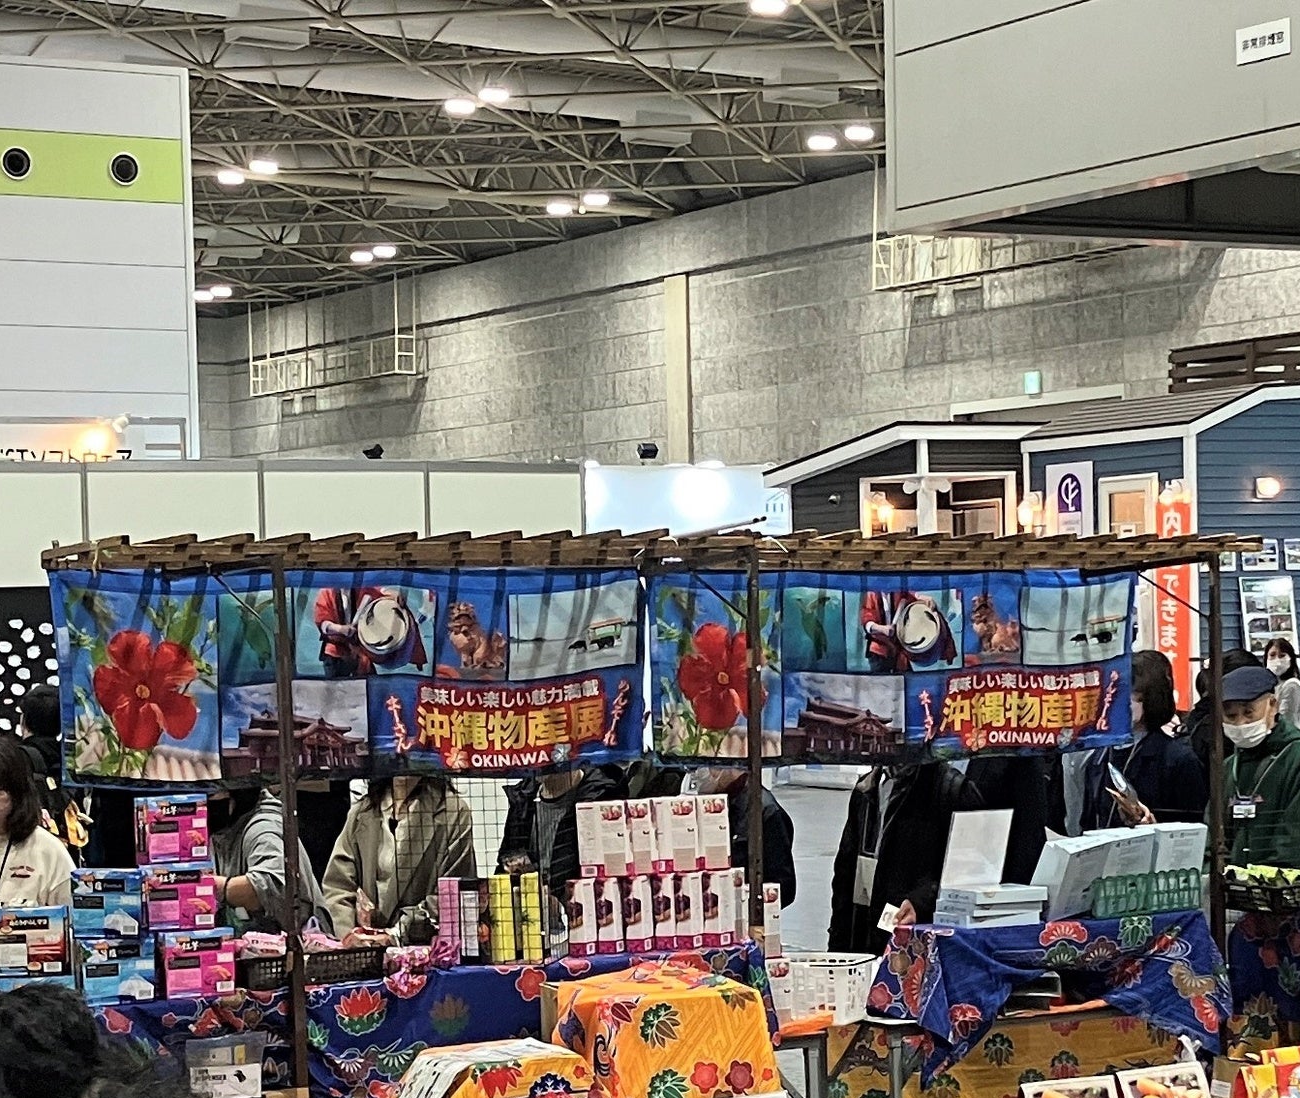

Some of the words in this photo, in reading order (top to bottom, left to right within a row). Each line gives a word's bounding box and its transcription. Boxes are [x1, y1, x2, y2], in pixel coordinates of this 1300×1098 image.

[420, 679, 600, 708] 美味しい楽しい魅力満載
[417, 697, 605, 750] 沖縄物産展
[940, 689, 1100, 732] 沖縄物産展
[988, 731, 1055, 745] OKINAWA
[471, 751, 550, 768] OKINAWA
